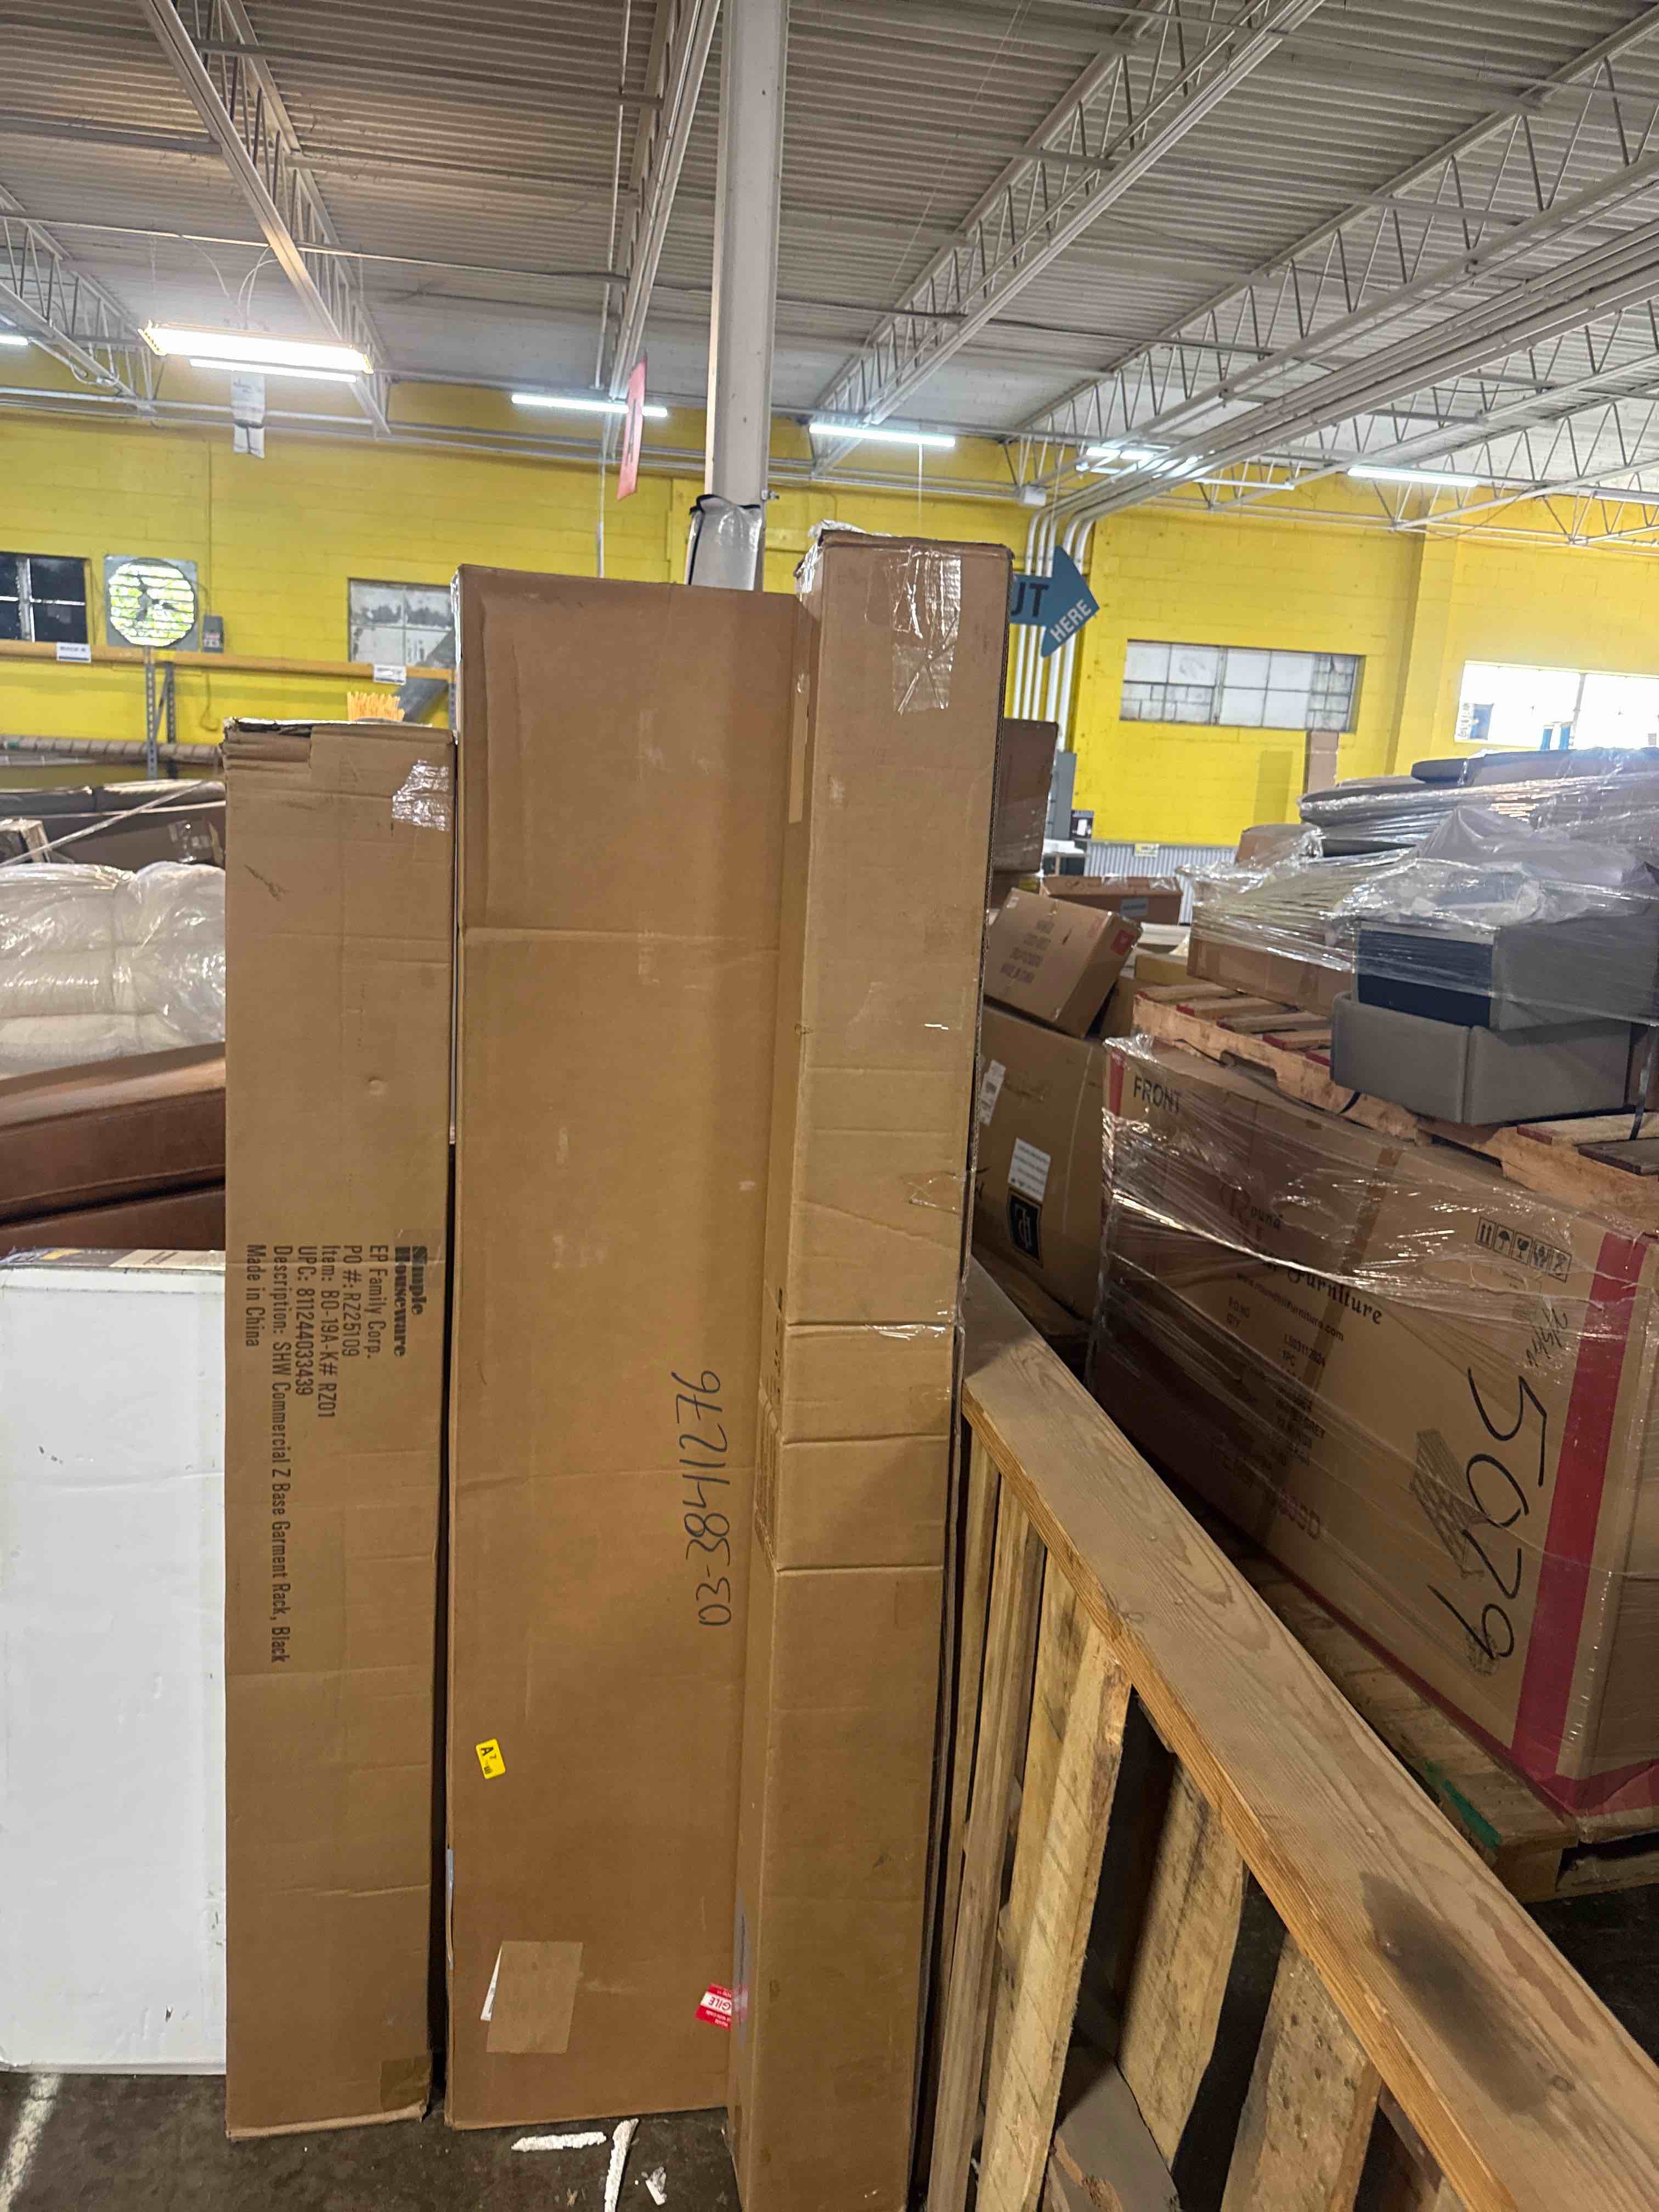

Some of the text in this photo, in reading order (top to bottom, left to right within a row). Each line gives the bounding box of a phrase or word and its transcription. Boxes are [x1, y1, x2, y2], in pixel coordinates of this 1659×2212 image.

[1049, 599, 1092, 642] HERE
[1133, 1074, 1181, 1115] FRONT
[245, 1244, 267, 1347] Made in China
[321, 1245, 341, 1283] Item:
[342, 1245, 363, 1265] PO
[409, 1246, 428, 1316] Simple
[295, 1246, 318, 1396] UPC: 811244033439
[341, 1292, 362, 1357] RZ25109
[364, 1245, 389, 1359] EP Family Corp.
[393, 1246, 411, 1357] Houseware
[317, 1383, 337, 1418] RZ01
[269, 1245, 294, 1663] Description: SHW Commercial Z Base Garment Rack, Black
[671, 1370, 732, 1626] 03-3841276
[1427, 1367, 1547, 1660] 5079
